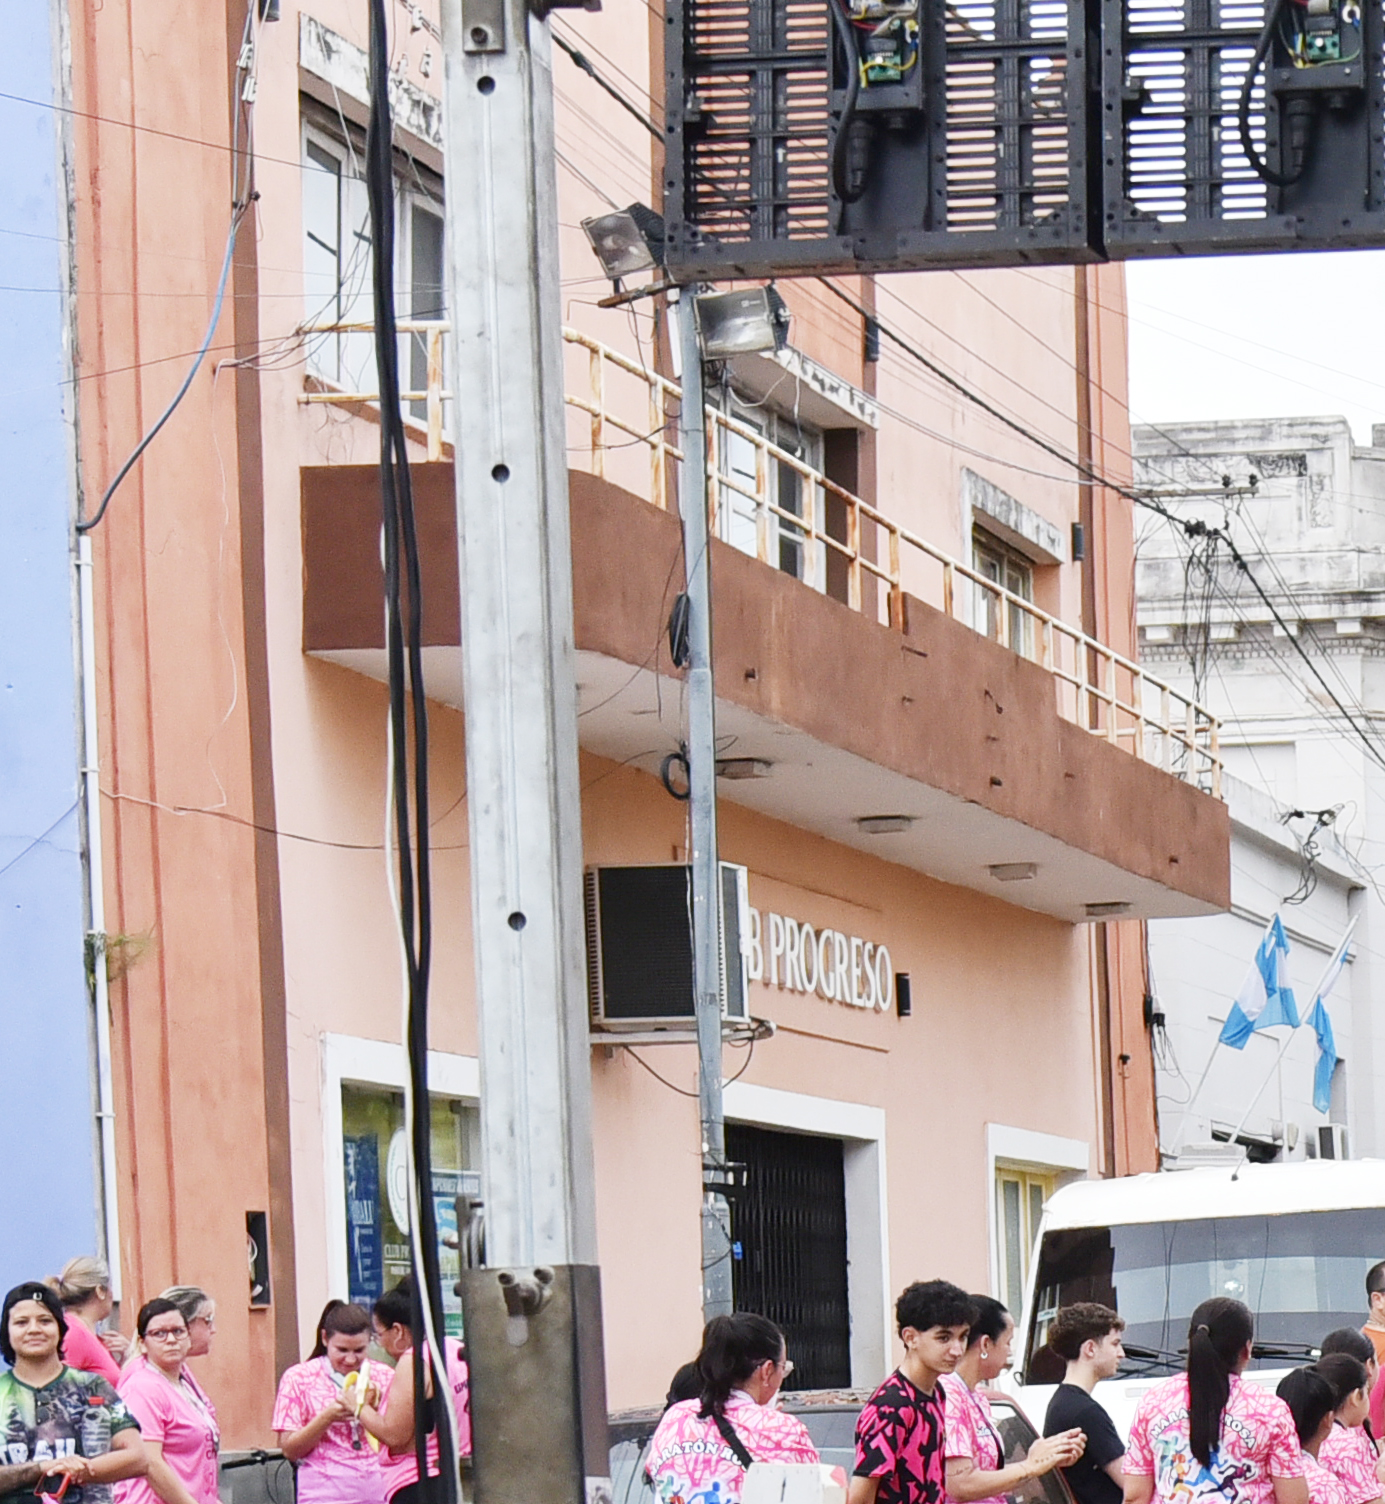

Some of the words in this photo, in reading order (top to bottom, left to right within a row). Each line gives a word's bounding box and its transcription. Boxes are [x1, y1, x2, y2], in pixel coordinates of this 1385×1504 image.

[769, 912, 893, 1011] PROGRESO
[1151, 1407, 1190, 1439] MARA
[1223, 1413, 1258, 1449] ROSA
